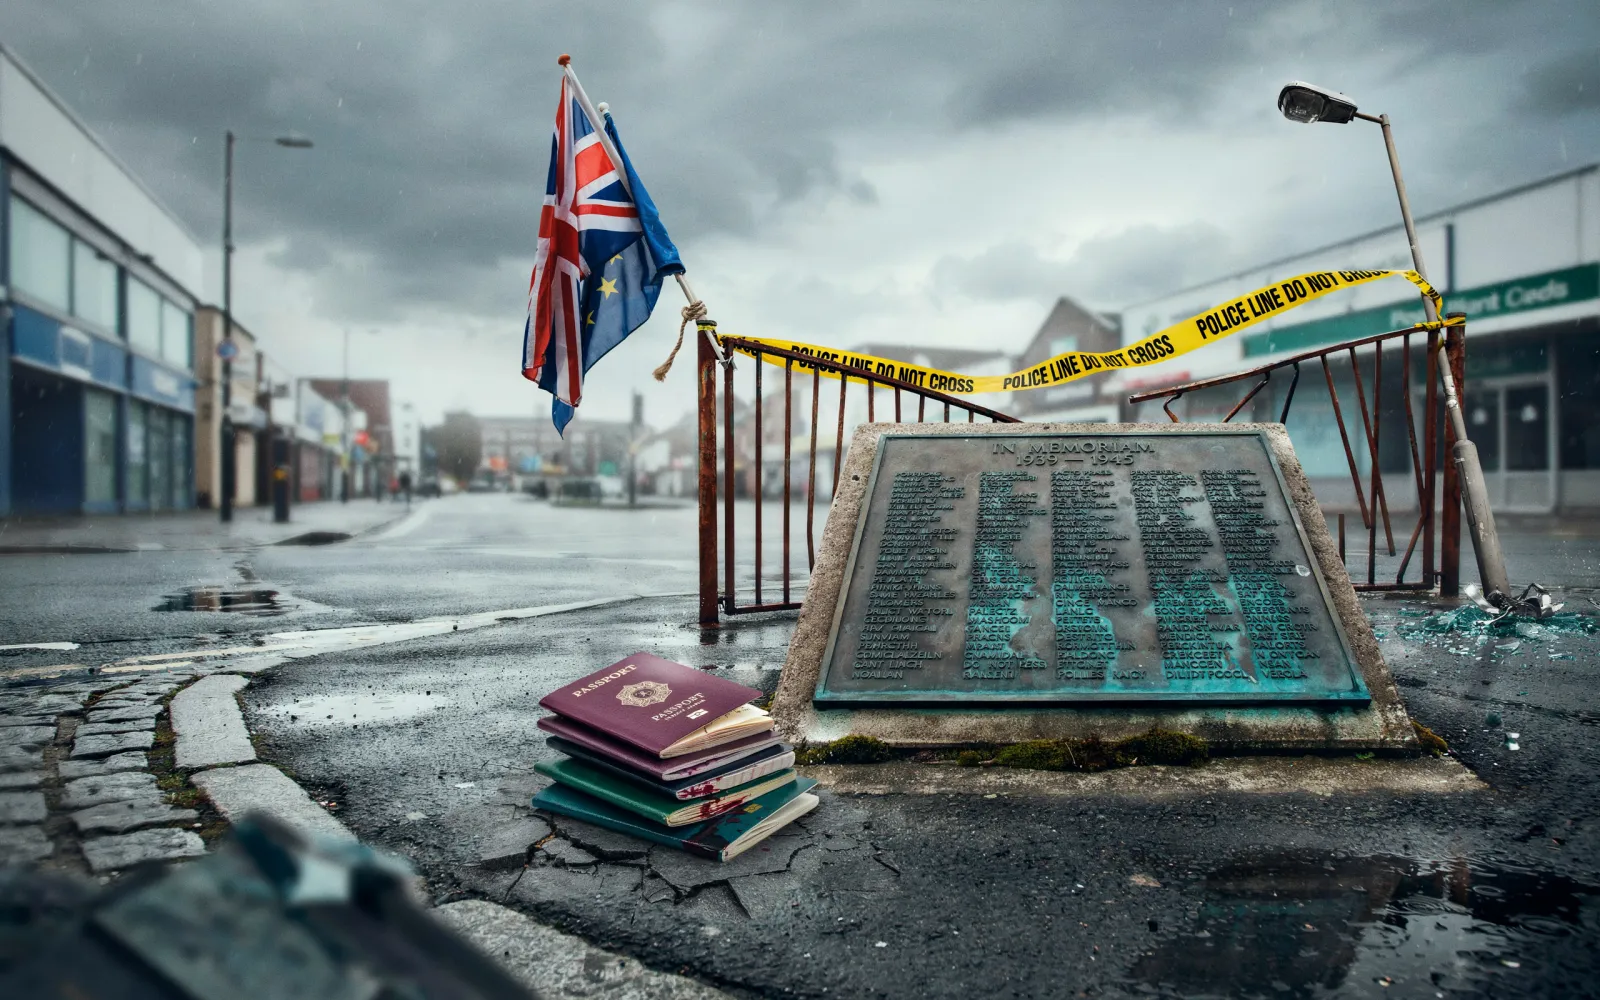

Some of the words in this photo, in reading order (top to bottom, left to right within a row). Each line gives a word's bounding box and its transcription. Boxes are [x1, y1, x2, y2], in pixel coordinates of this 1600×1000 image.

[1196, 301, 1250, 340] POLICE
[1247, 287, 1285, 318] LINE
[1281, 279, 1307, 303] DO
[1304, 272, 1339, 293] NOT
[1002, 366, 1049, 389] POLICE
[1050, 355, 1081, 382] LINE
[1079, 354, 1102, 371] DO
[1100, 353, 1129, 367] NOT
[1127, 334, 1175, 364] CROSS
[898, 367, 926, 387] NOT
[929, 373, 974, 393] CROSS
[992, 443, 1016, 455] IN
[1028, 442, 1155, 454] MEMORIAM
[1015, 455, 1059, 467] 1939
[1090, 455, 1135, 466] 1945
[572, 664, 638, 698] PASSPORT
